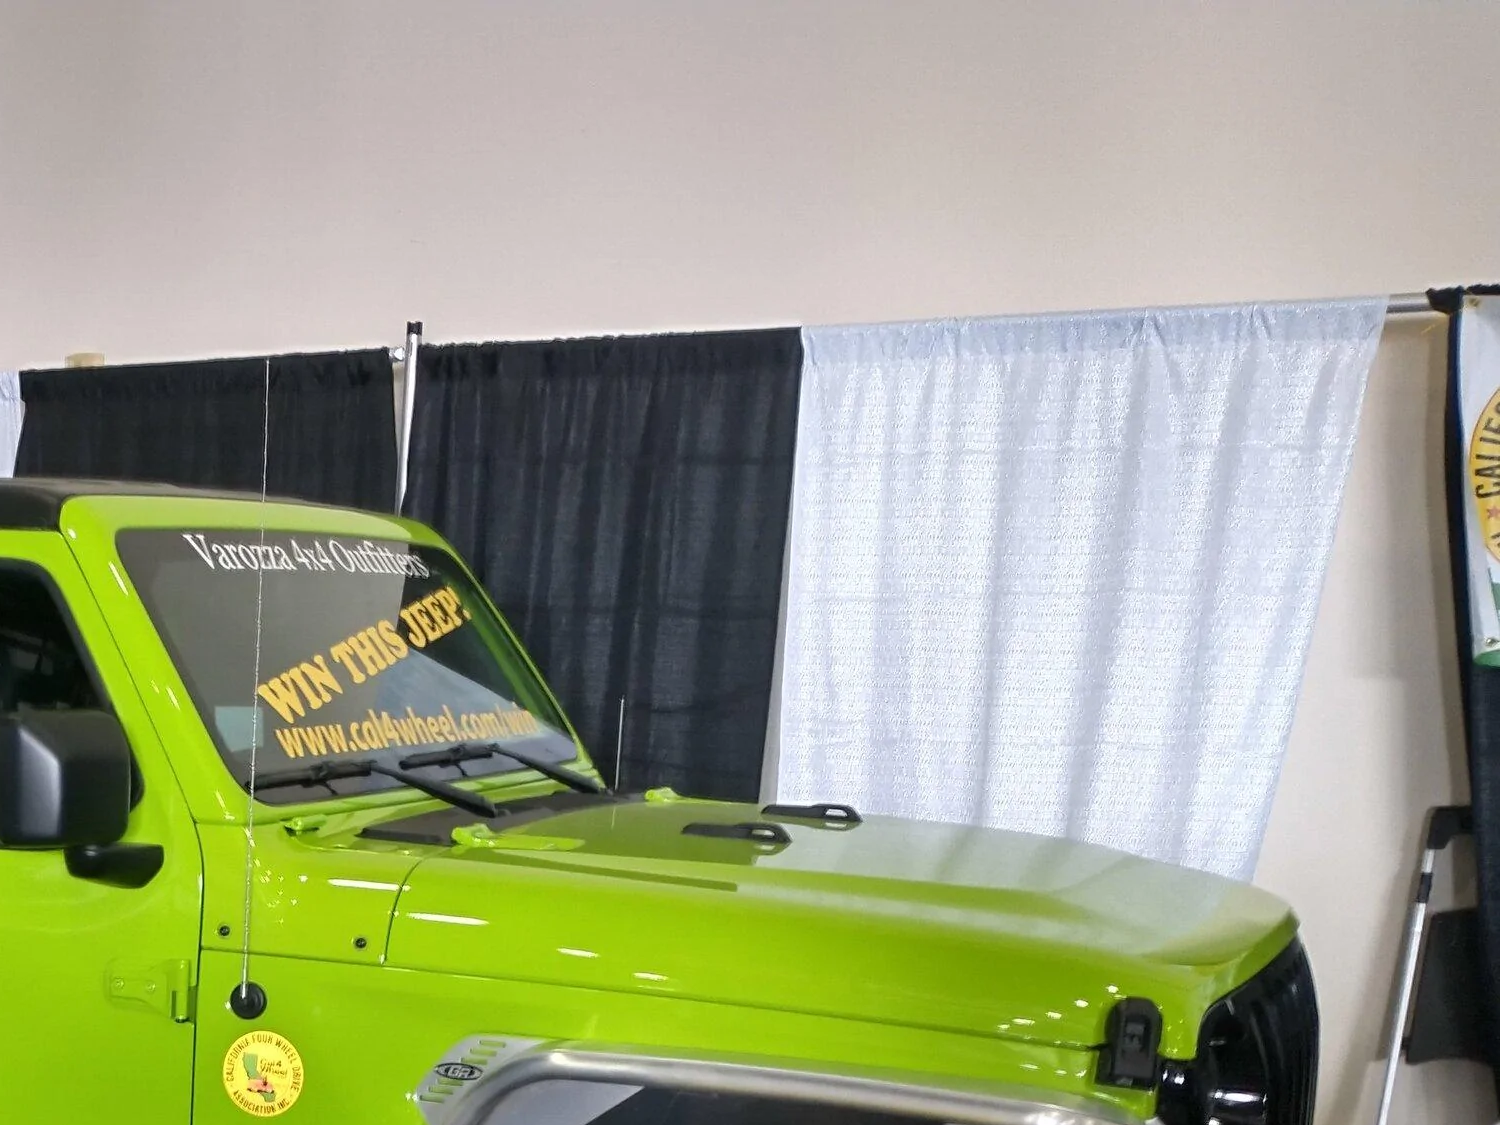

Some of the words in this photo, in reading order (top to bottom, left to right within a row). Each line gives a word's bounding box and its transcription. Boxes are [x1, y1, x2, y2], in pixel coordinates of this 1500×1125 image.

[182, 533, 298, 570] Varozza
[291, 539, 337, 571] 4x4
[329, 539, 431, 579] Outfitters
[257, 654, 343, 724] WIN
[330, 619, 409, 684] THIS
[399, 586, 472, 648] JEEP!
[226, 1037, 250, 1082] CALIFORNIA
[251, 1034, 274, 1044] FOUR
[275, 1038, 297, 1064] WHEEL
[290, 1066, 302, 1092] DRIVE
[233, 1089, 277, 1114] ASSOCIATION
